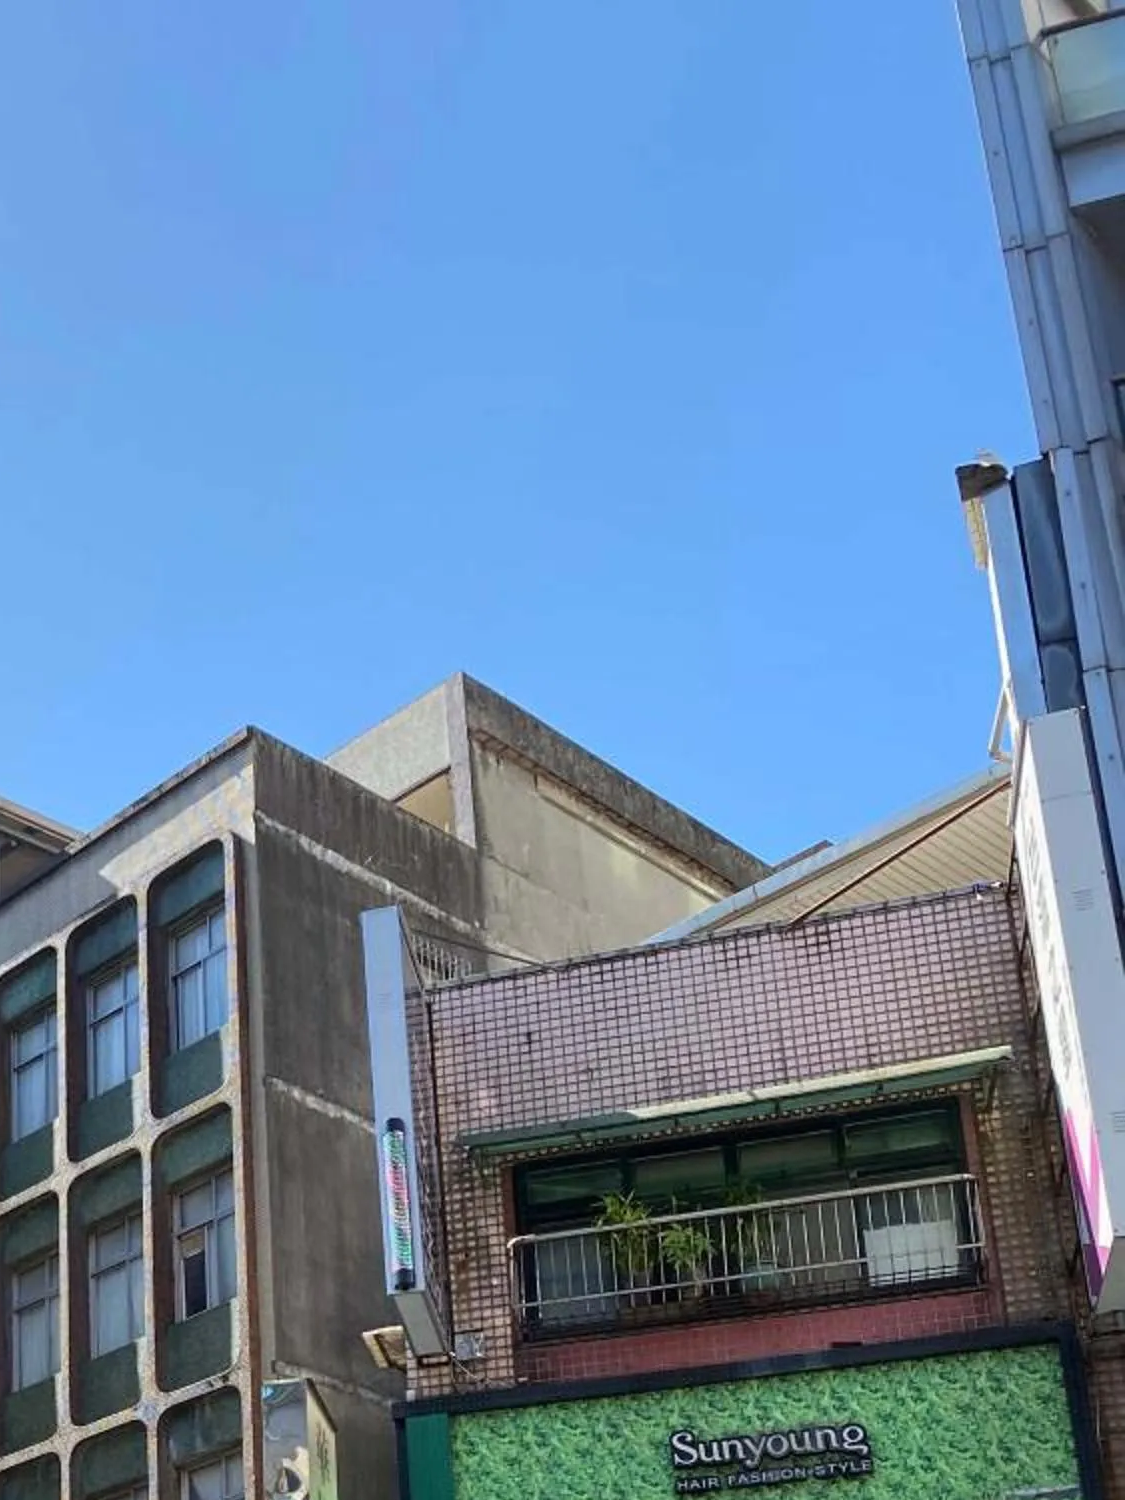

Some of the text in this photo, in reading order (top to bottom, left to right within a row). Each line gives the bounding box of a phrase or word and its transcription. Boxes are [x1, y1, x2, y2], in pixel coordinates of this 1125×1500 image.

[671, 1425, 869, 1467] Sunyoung
[677, 1476, 720, 1492] HAIR
[814, 1459, 872, 1476] STYLE
